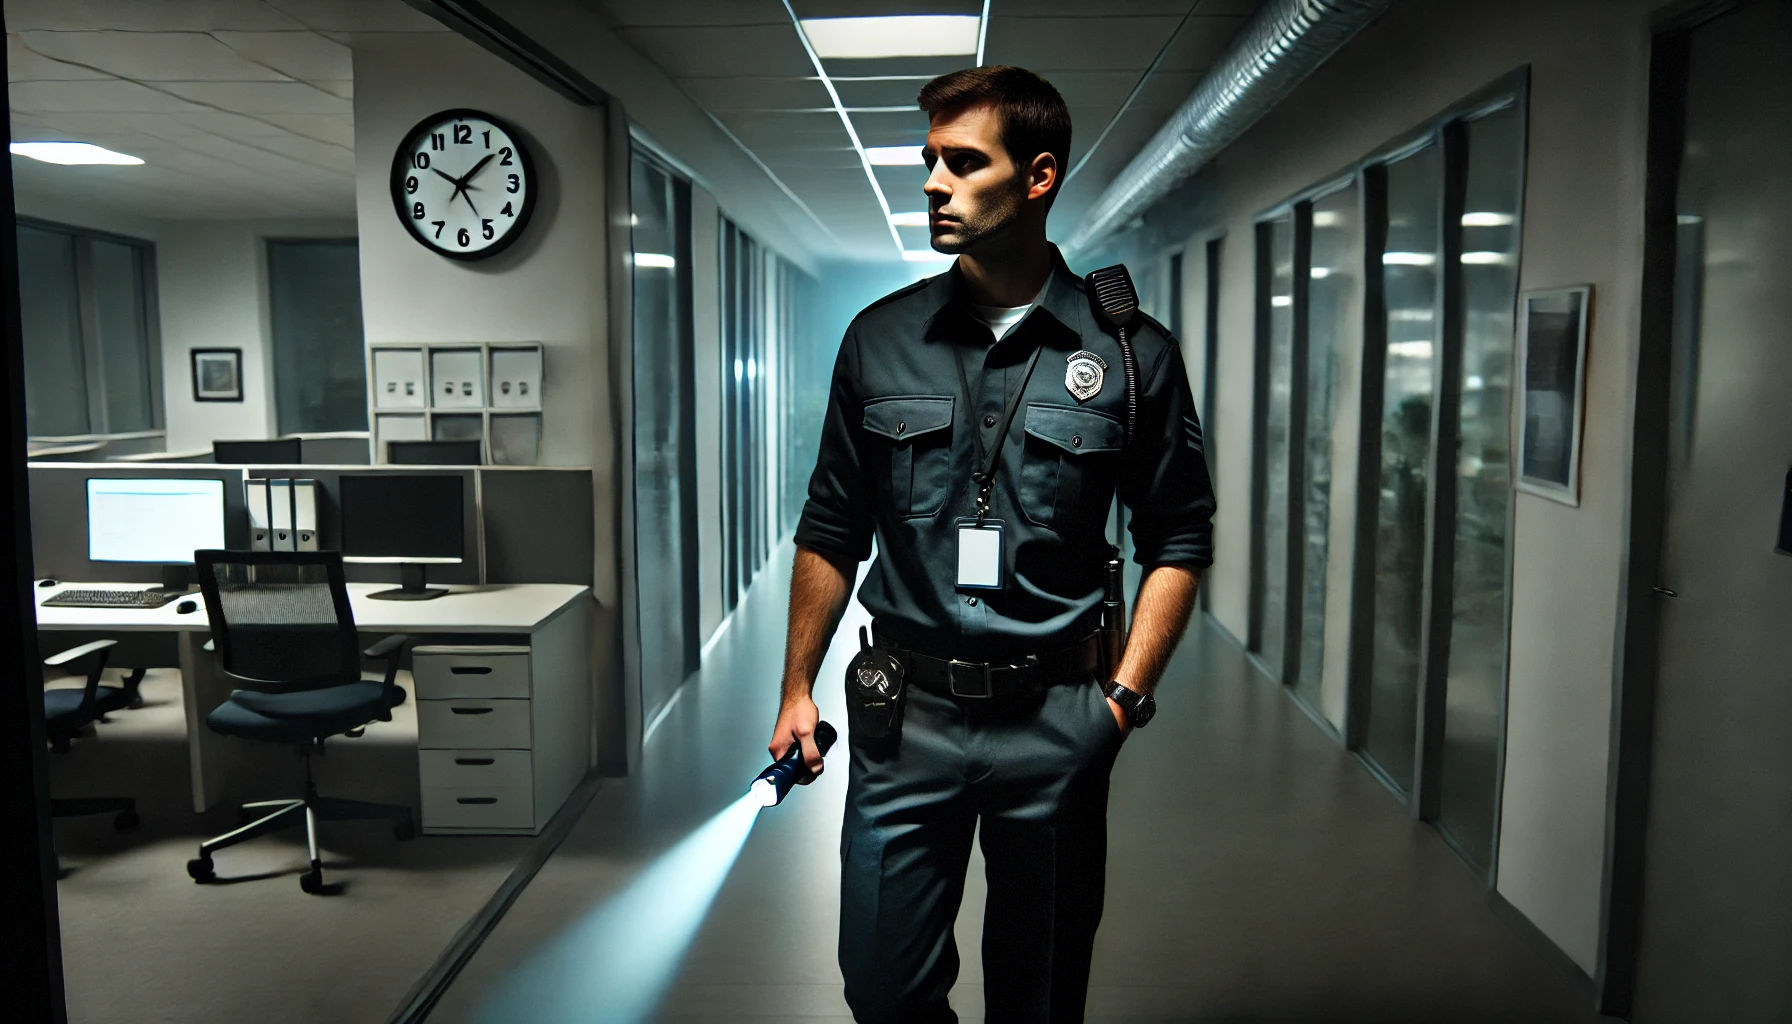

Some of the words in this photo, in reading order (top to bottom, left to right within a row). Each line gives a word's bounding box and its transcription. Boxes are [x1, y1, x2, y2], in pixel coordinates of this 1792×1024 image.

[431, 133, 445, 151] 11
[453, 124, 473, 144] 12
[482, 130, 491, 149] 1
[411, 152, 430, 169] 10
[498, 147, 513, 166] 2
[406, 176, 419, 194] 9
[506, 174, 520, 193] 3
[413, 202, 425, 219] 8
[500, 201, 514, 217] 4
[431, 220, 446, 239] 7
[457, 228, 470, 247] 6
[482, 218, 494, 240] 5
